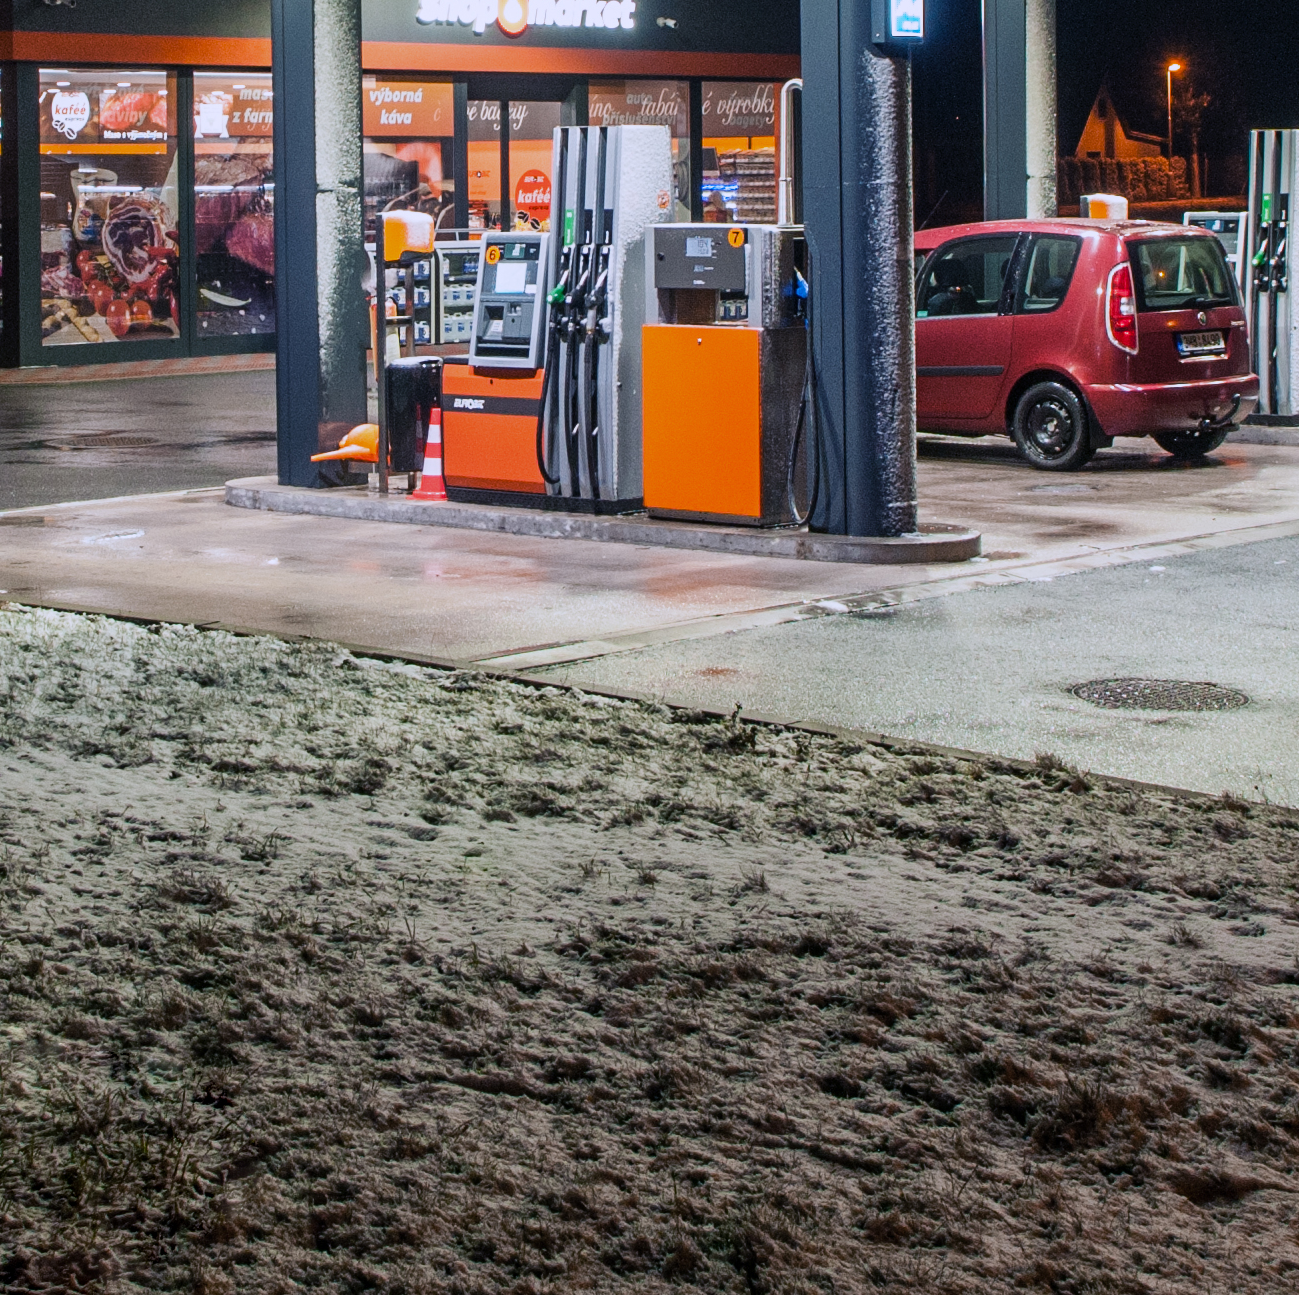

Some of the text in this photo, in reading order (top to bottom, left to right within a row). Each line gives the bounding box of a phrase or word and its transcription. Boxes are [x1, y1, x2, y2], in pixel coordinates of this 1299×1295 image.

[369, 87, 423, 106] výborná
[380, 108, 412, 125] káva
[732, 231, 740, 244] 7
[489, 249, 497, 261] 6
